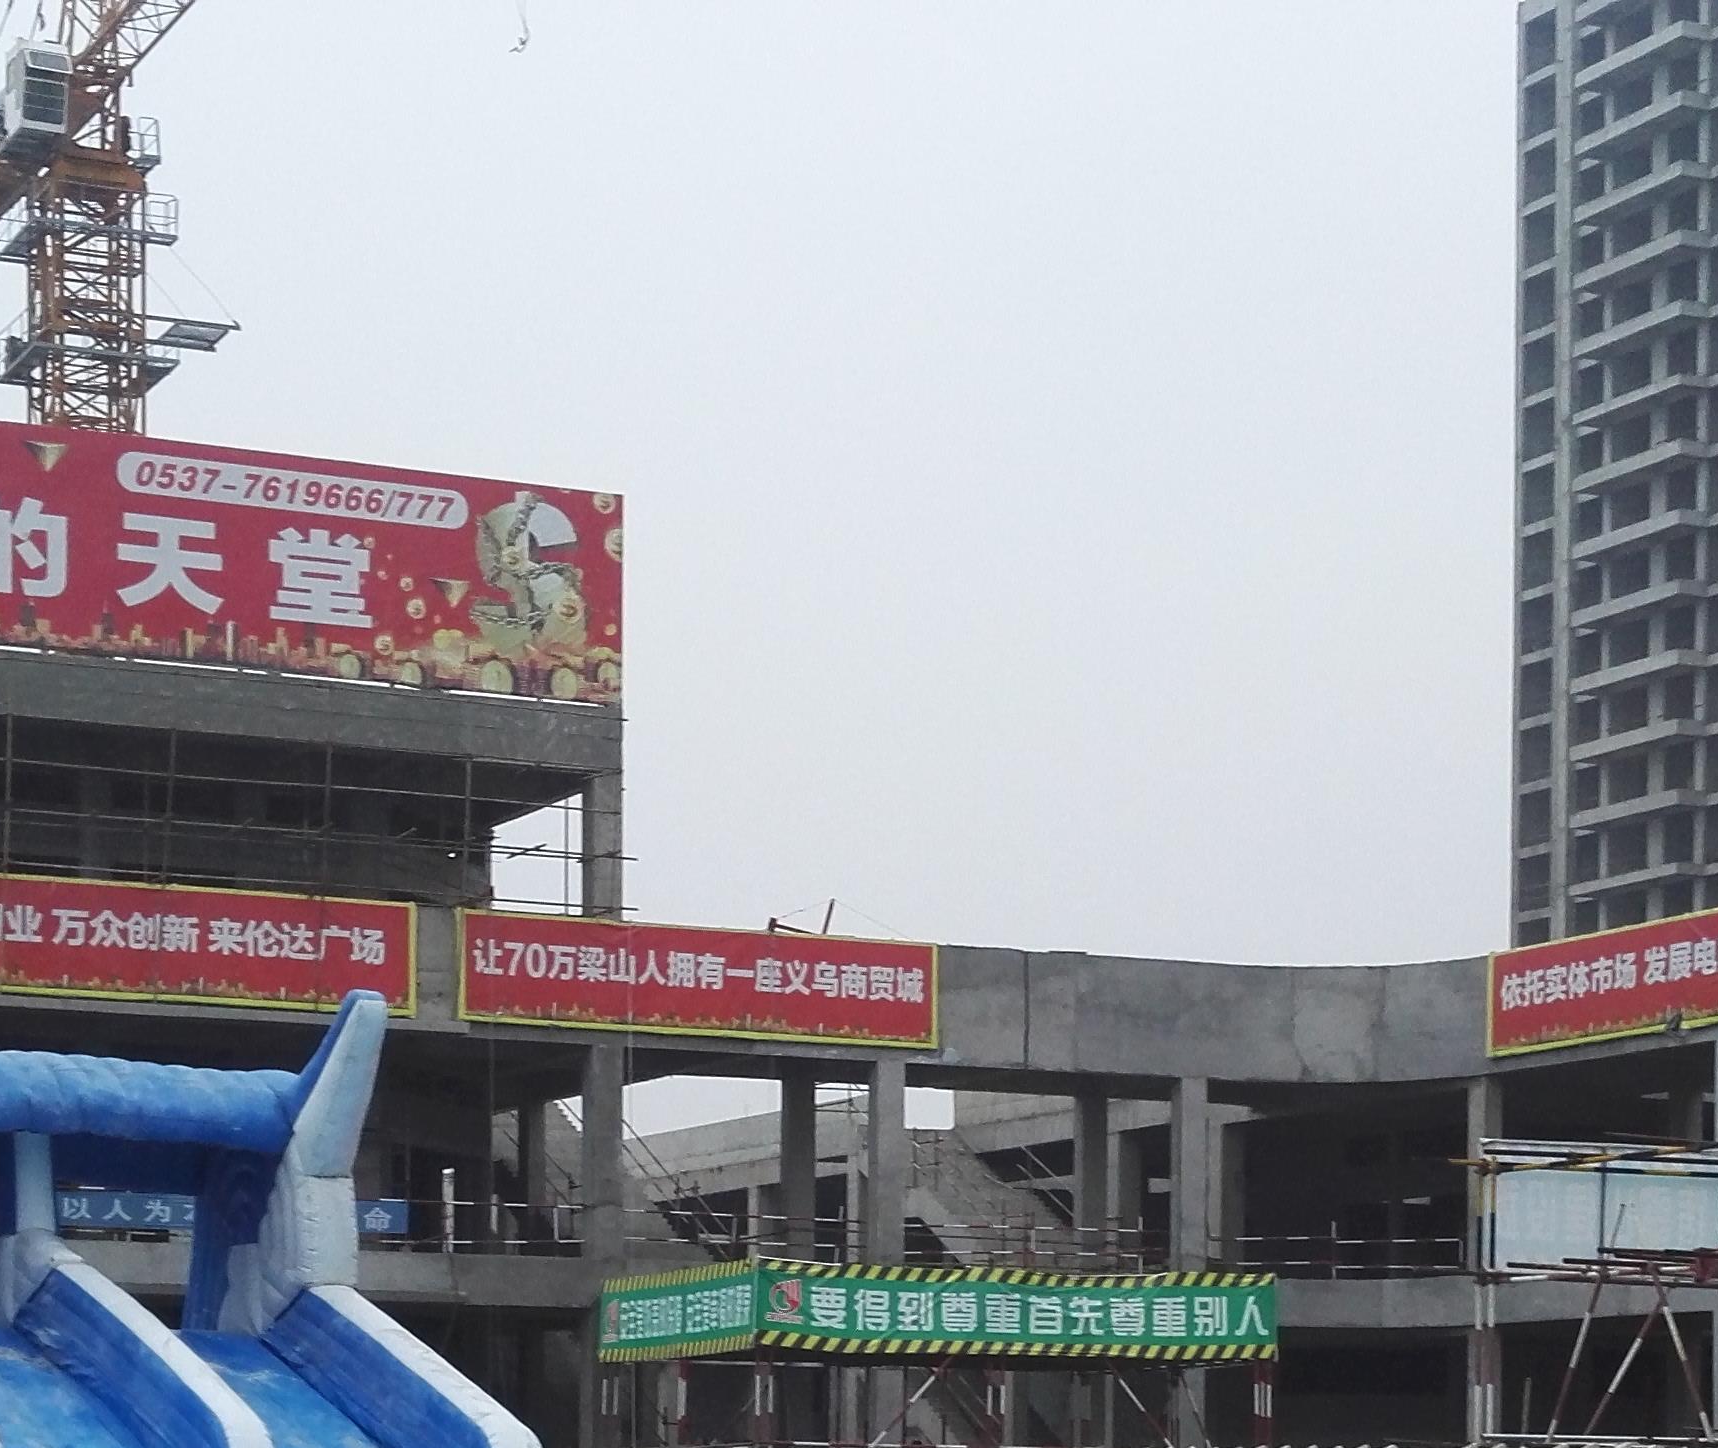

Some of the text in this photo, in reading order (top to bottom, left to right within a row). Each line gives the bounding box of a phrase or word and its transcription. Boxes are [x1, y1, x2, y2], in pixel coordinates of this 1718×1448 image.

[135, 460, 455, 521] 0537-7619666/777
[51, 908, 198, 953] 万众创新
[208, 917, 385, 965] 来伦达广场
[474, 938, 924, 1003] 让70万梁山人拥有一座义乌商贸城
[1501, 953, 1636, 1010] 依托实体市场
[810, 1286, 1268, 1337] 要得到尊重首先尊重别人
